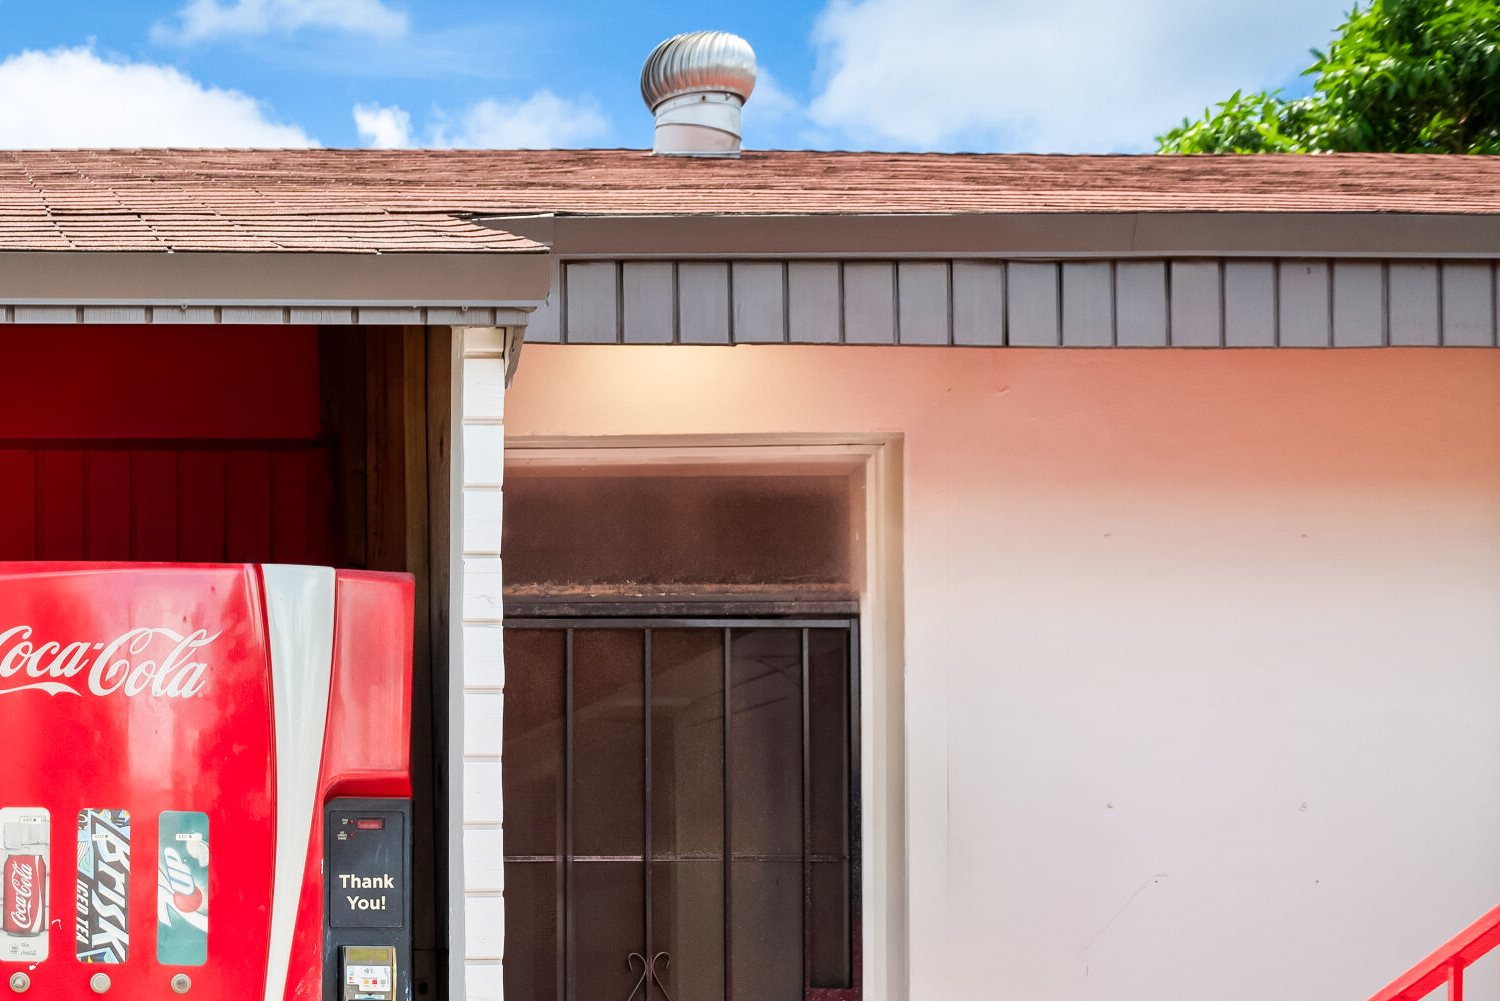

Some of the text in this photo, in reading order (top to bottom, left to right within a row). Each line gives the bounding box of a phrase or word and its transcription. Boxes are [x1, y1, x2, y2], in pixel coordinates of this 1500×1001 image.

[10, 859, 33, 929] Coca-Cola
[338, 874, 395, 889] Thank
[76, 878, 90, 945] ICED TEA
[346, 895, 386, 911] You!
